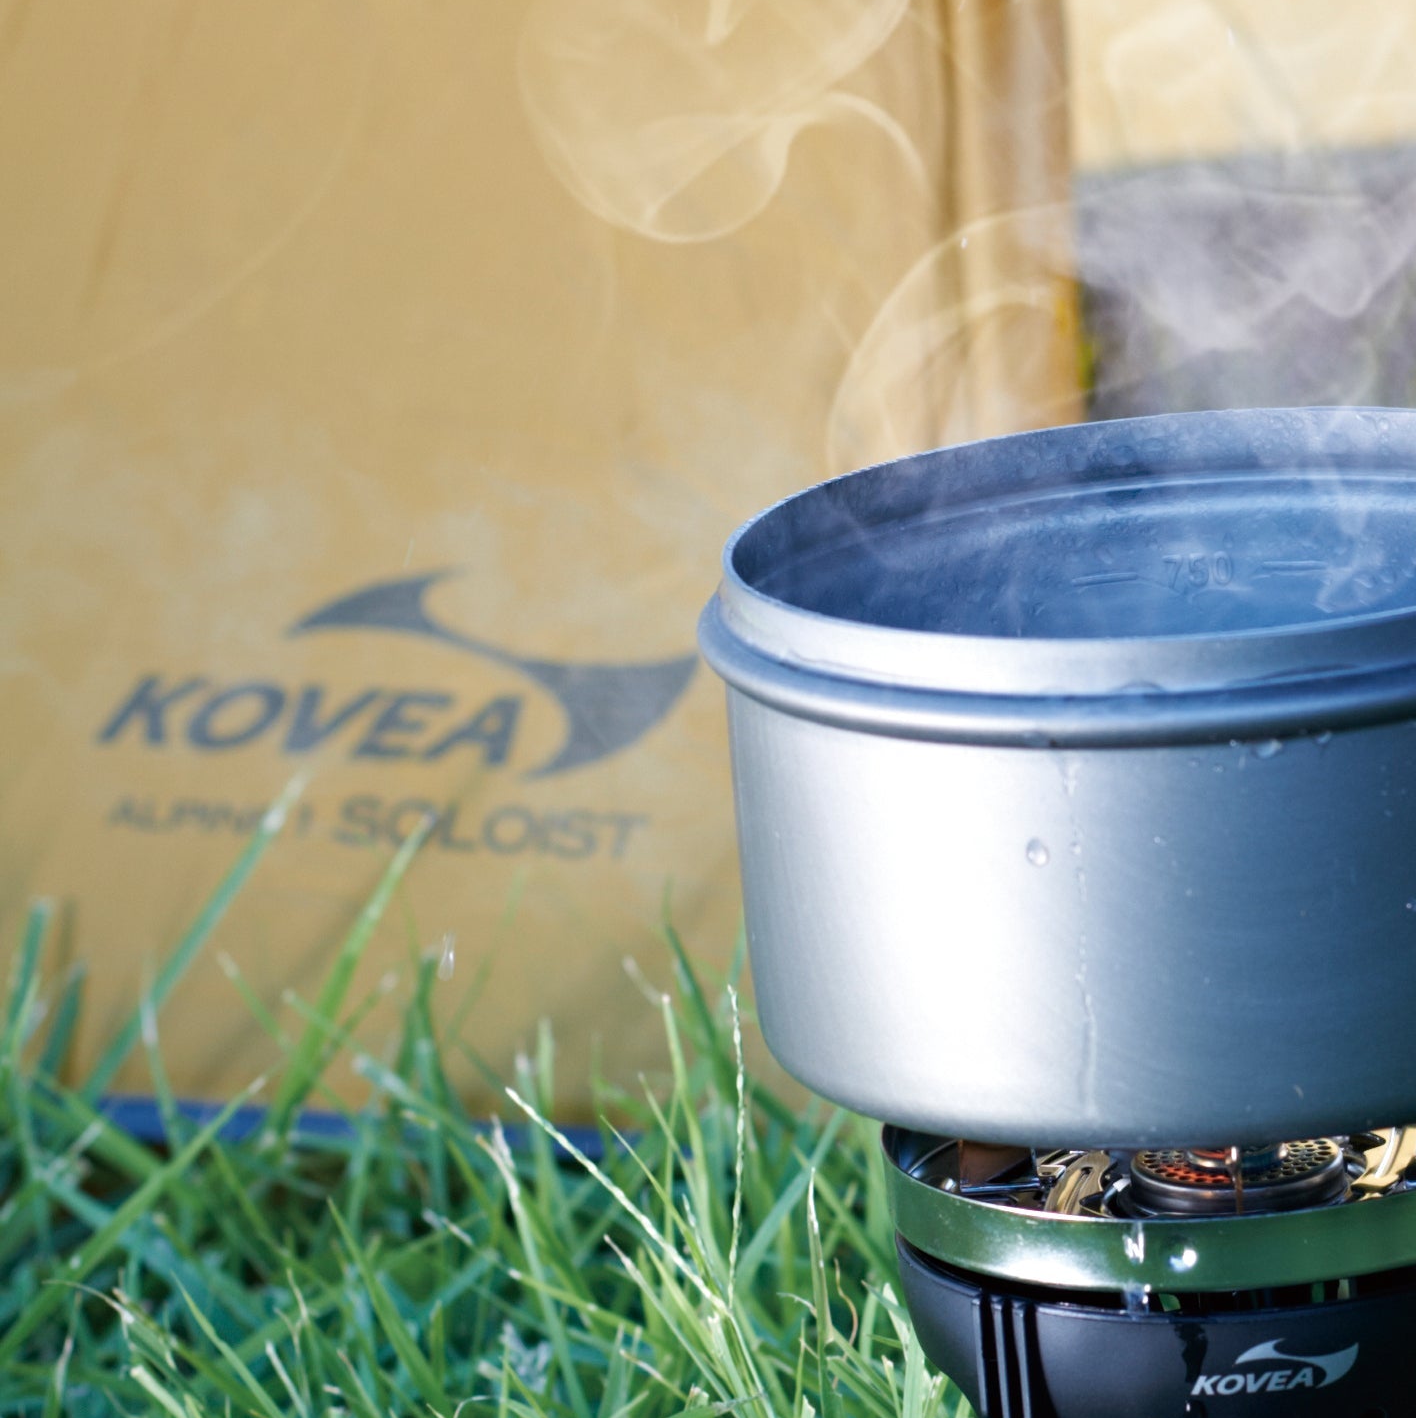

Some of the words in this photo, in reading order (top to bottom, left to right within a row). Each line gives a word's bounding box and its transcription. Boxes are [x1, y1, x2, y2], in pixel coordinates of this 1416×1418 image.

[95, 674, 524, 768] KOVEA
[332, 793, 650, 861] SOLOIST
[1190, 1367, 1314, 1396] KOVEA
